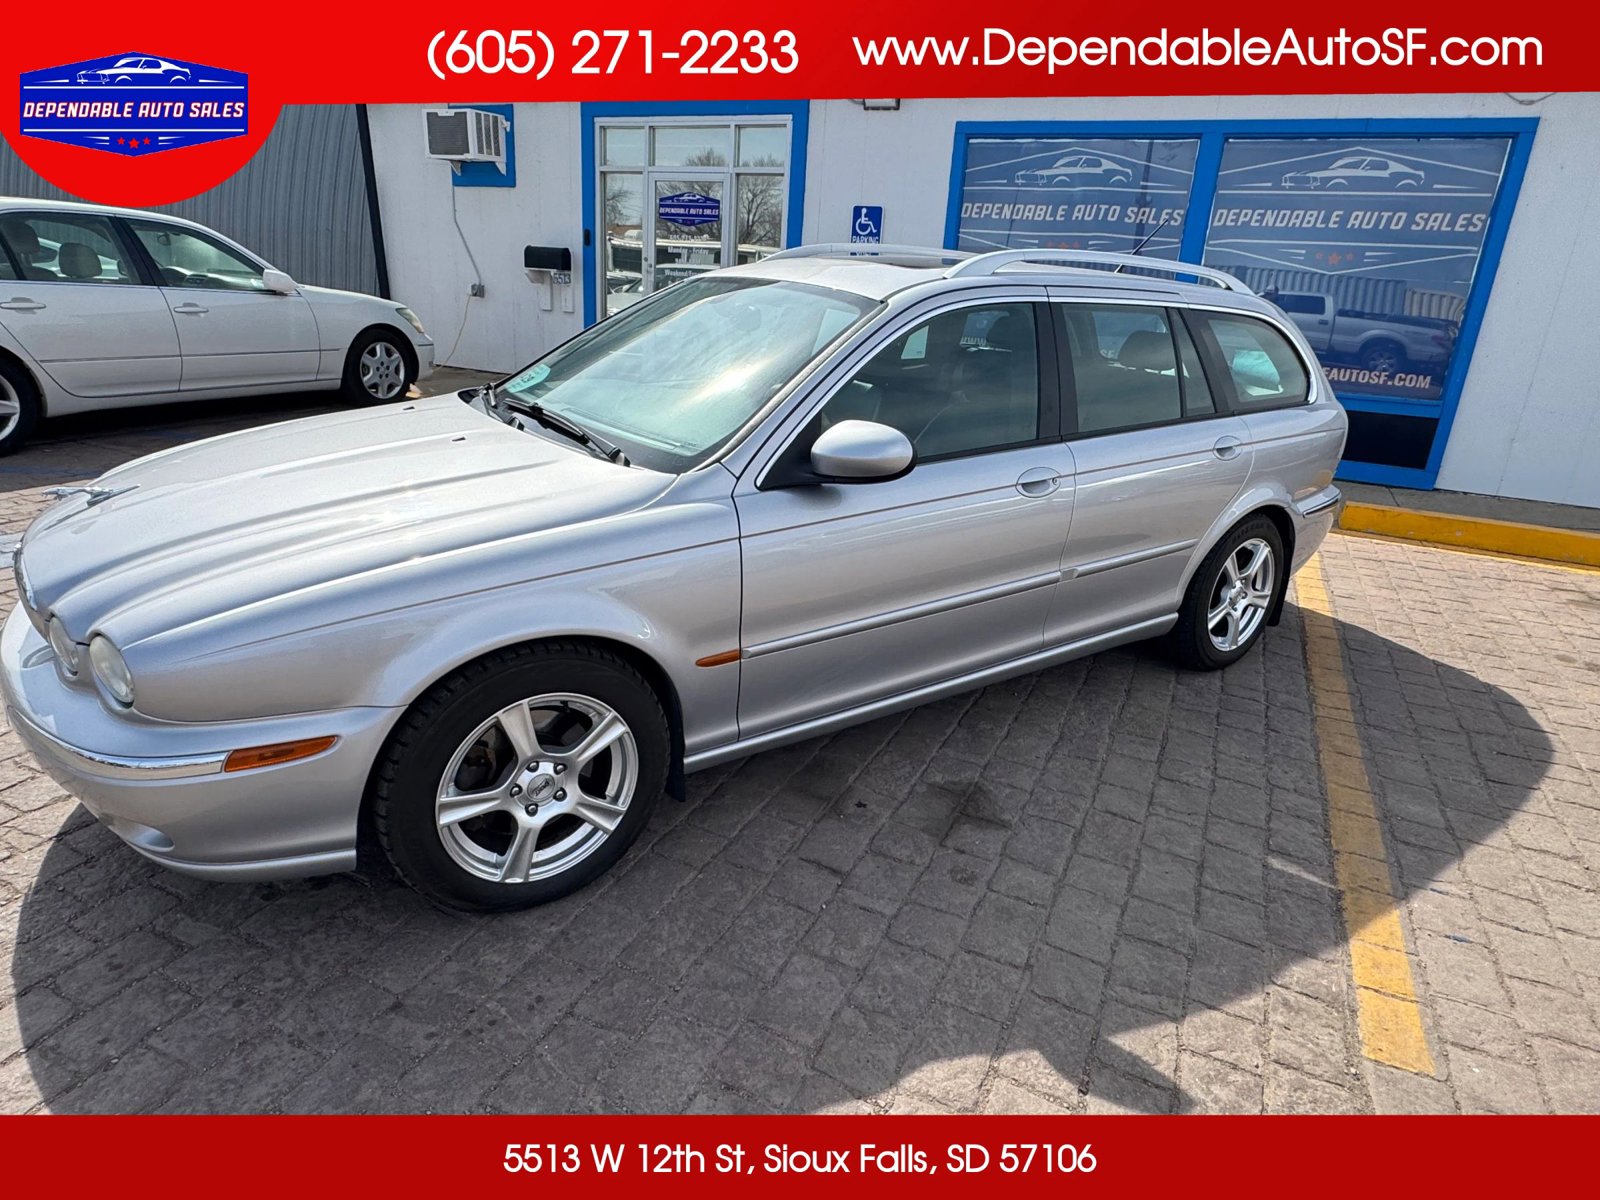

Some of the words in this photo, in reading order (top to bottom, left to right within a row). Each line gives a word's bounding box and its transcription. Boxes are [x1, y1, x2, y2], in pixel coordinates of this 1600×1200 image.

[659, 207, 689, 215] DEPENDABLE
[961, 202, 1069, 222] DEPENDABLE
[1071, 204, 1121, 222] AUTO
[1124, 207, 1185, 226] SALES
[1212, 208, 1344, 229] DEPENDABLE
[1346, 210, 1408, 231] AUTO
[1410, 212, 1488, 233] SALES
[552, 272, 572, 285] 5513
